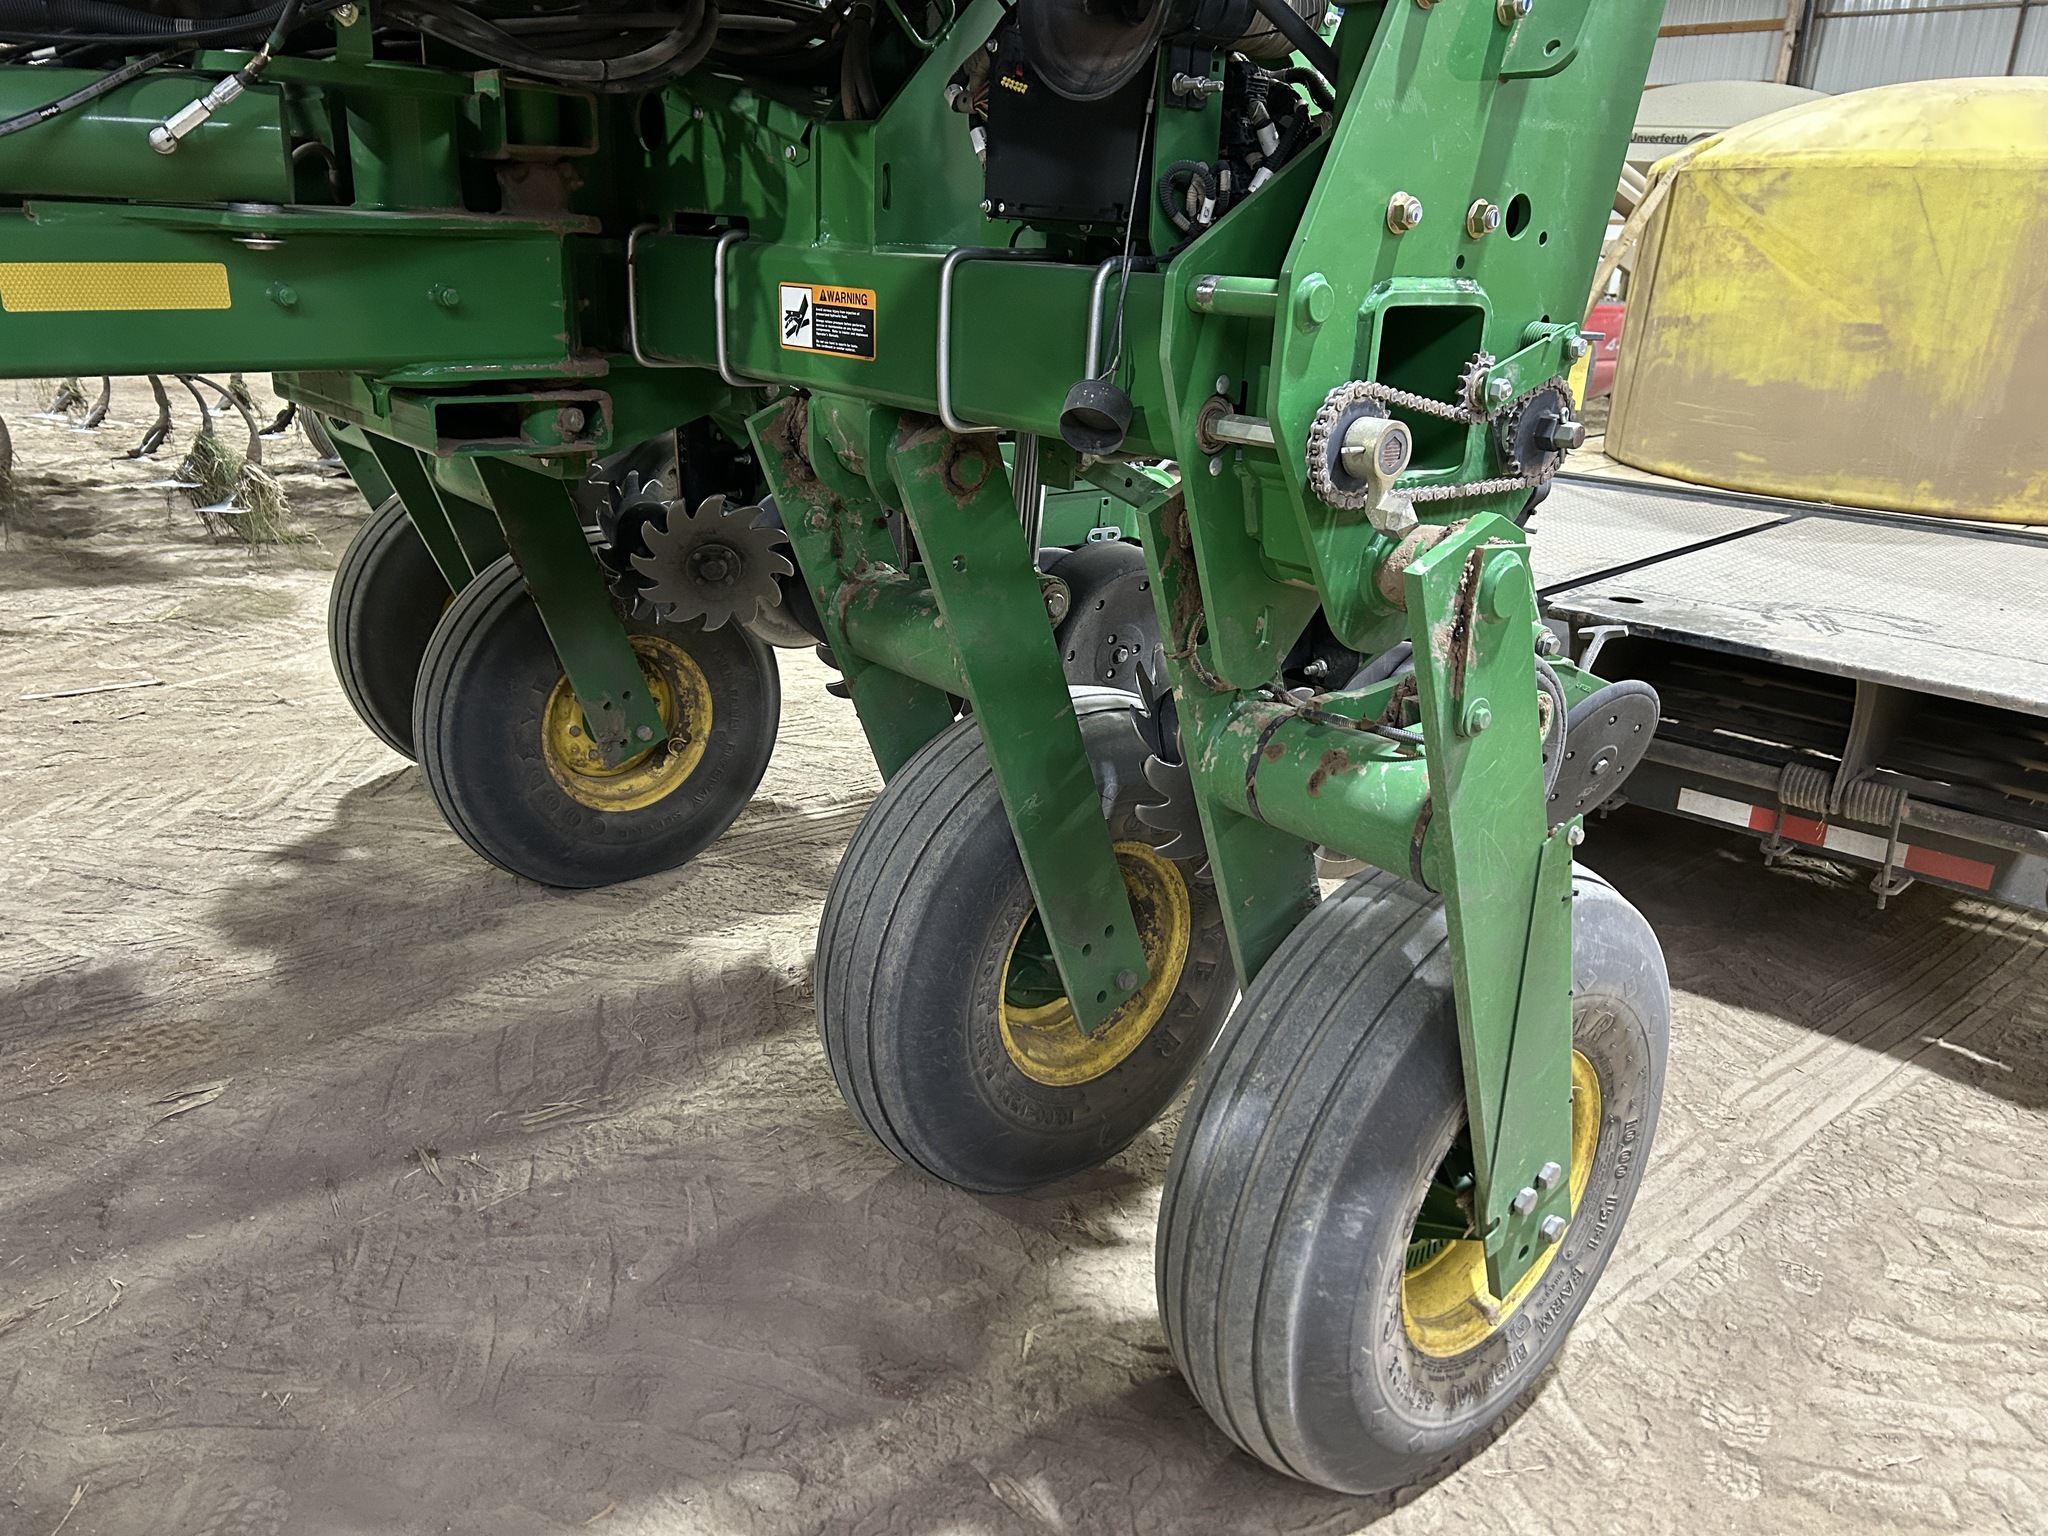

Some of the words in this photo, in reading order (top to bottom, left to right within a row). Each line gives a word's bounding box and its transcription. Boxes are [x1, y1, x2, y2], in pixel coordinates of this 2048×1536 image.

[826, 290, 868, 306] WARNING
[1536, 1264, 1586, 1337] FARM
[1445, 1342, 1528, 1413] HIGHWAY
